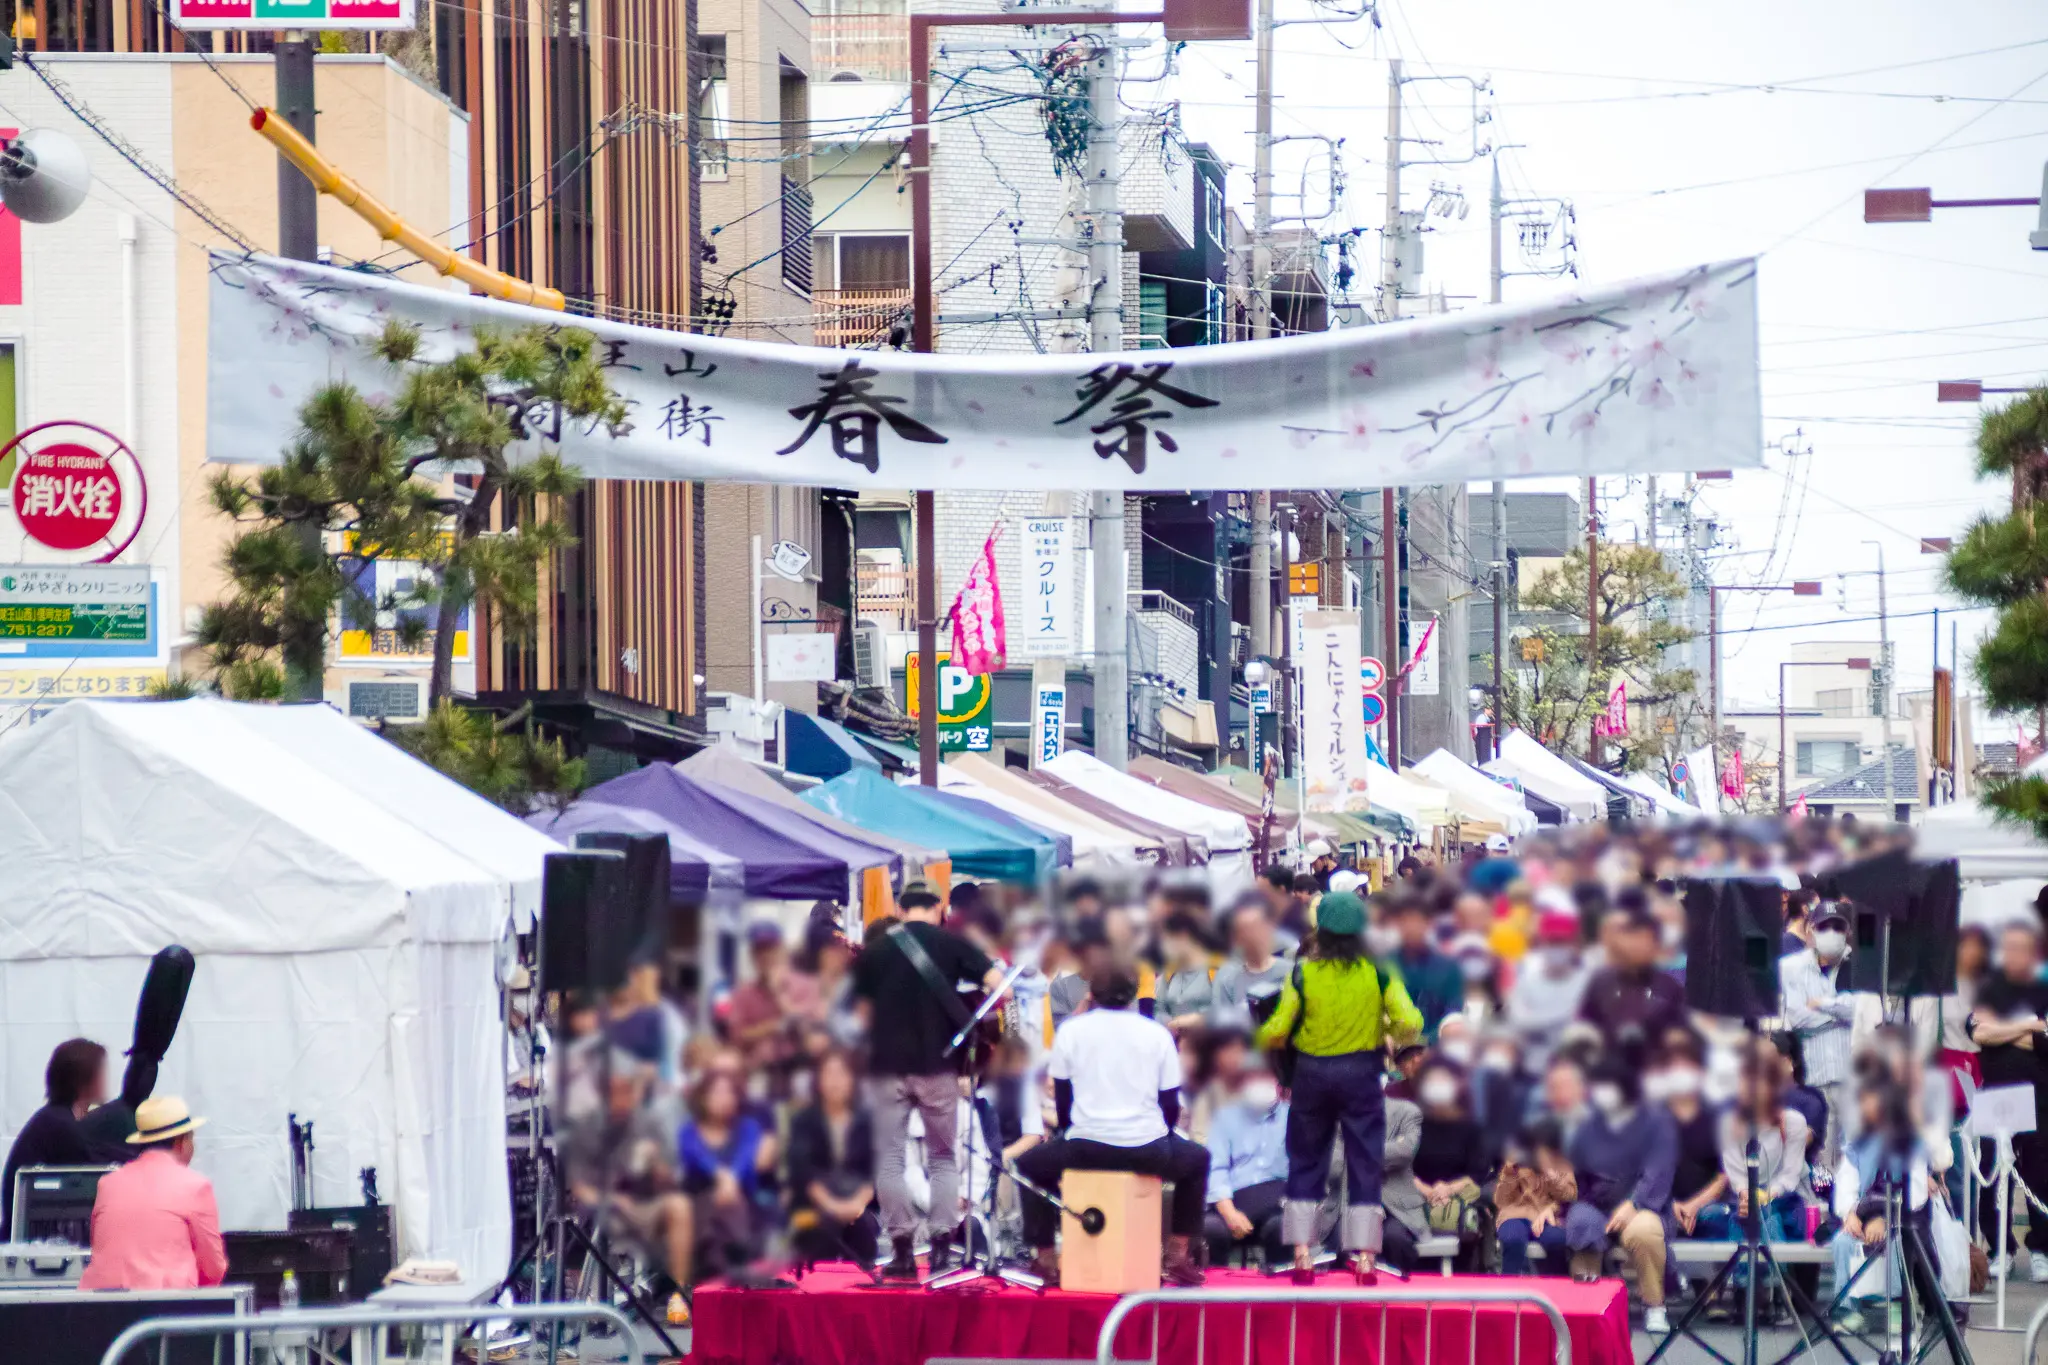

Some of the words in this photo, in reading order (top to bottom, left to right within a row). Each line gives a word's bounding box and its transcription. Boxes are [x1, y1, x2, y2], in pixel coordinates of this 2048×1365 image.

[30, 454, 55, 467] FIRE
[57, 455, 105, 469] HYDRANT
[21, 473, 117, 519] 消火栓
[1028, 522, 1065, 532] CRUISE
[6, 624, 75, 636] 751-2217
[940, 666, 974, 710] P
[1325, 632, 1348, 782] こんにゃくマルシェ
[966, 725, 990, 749] 空
